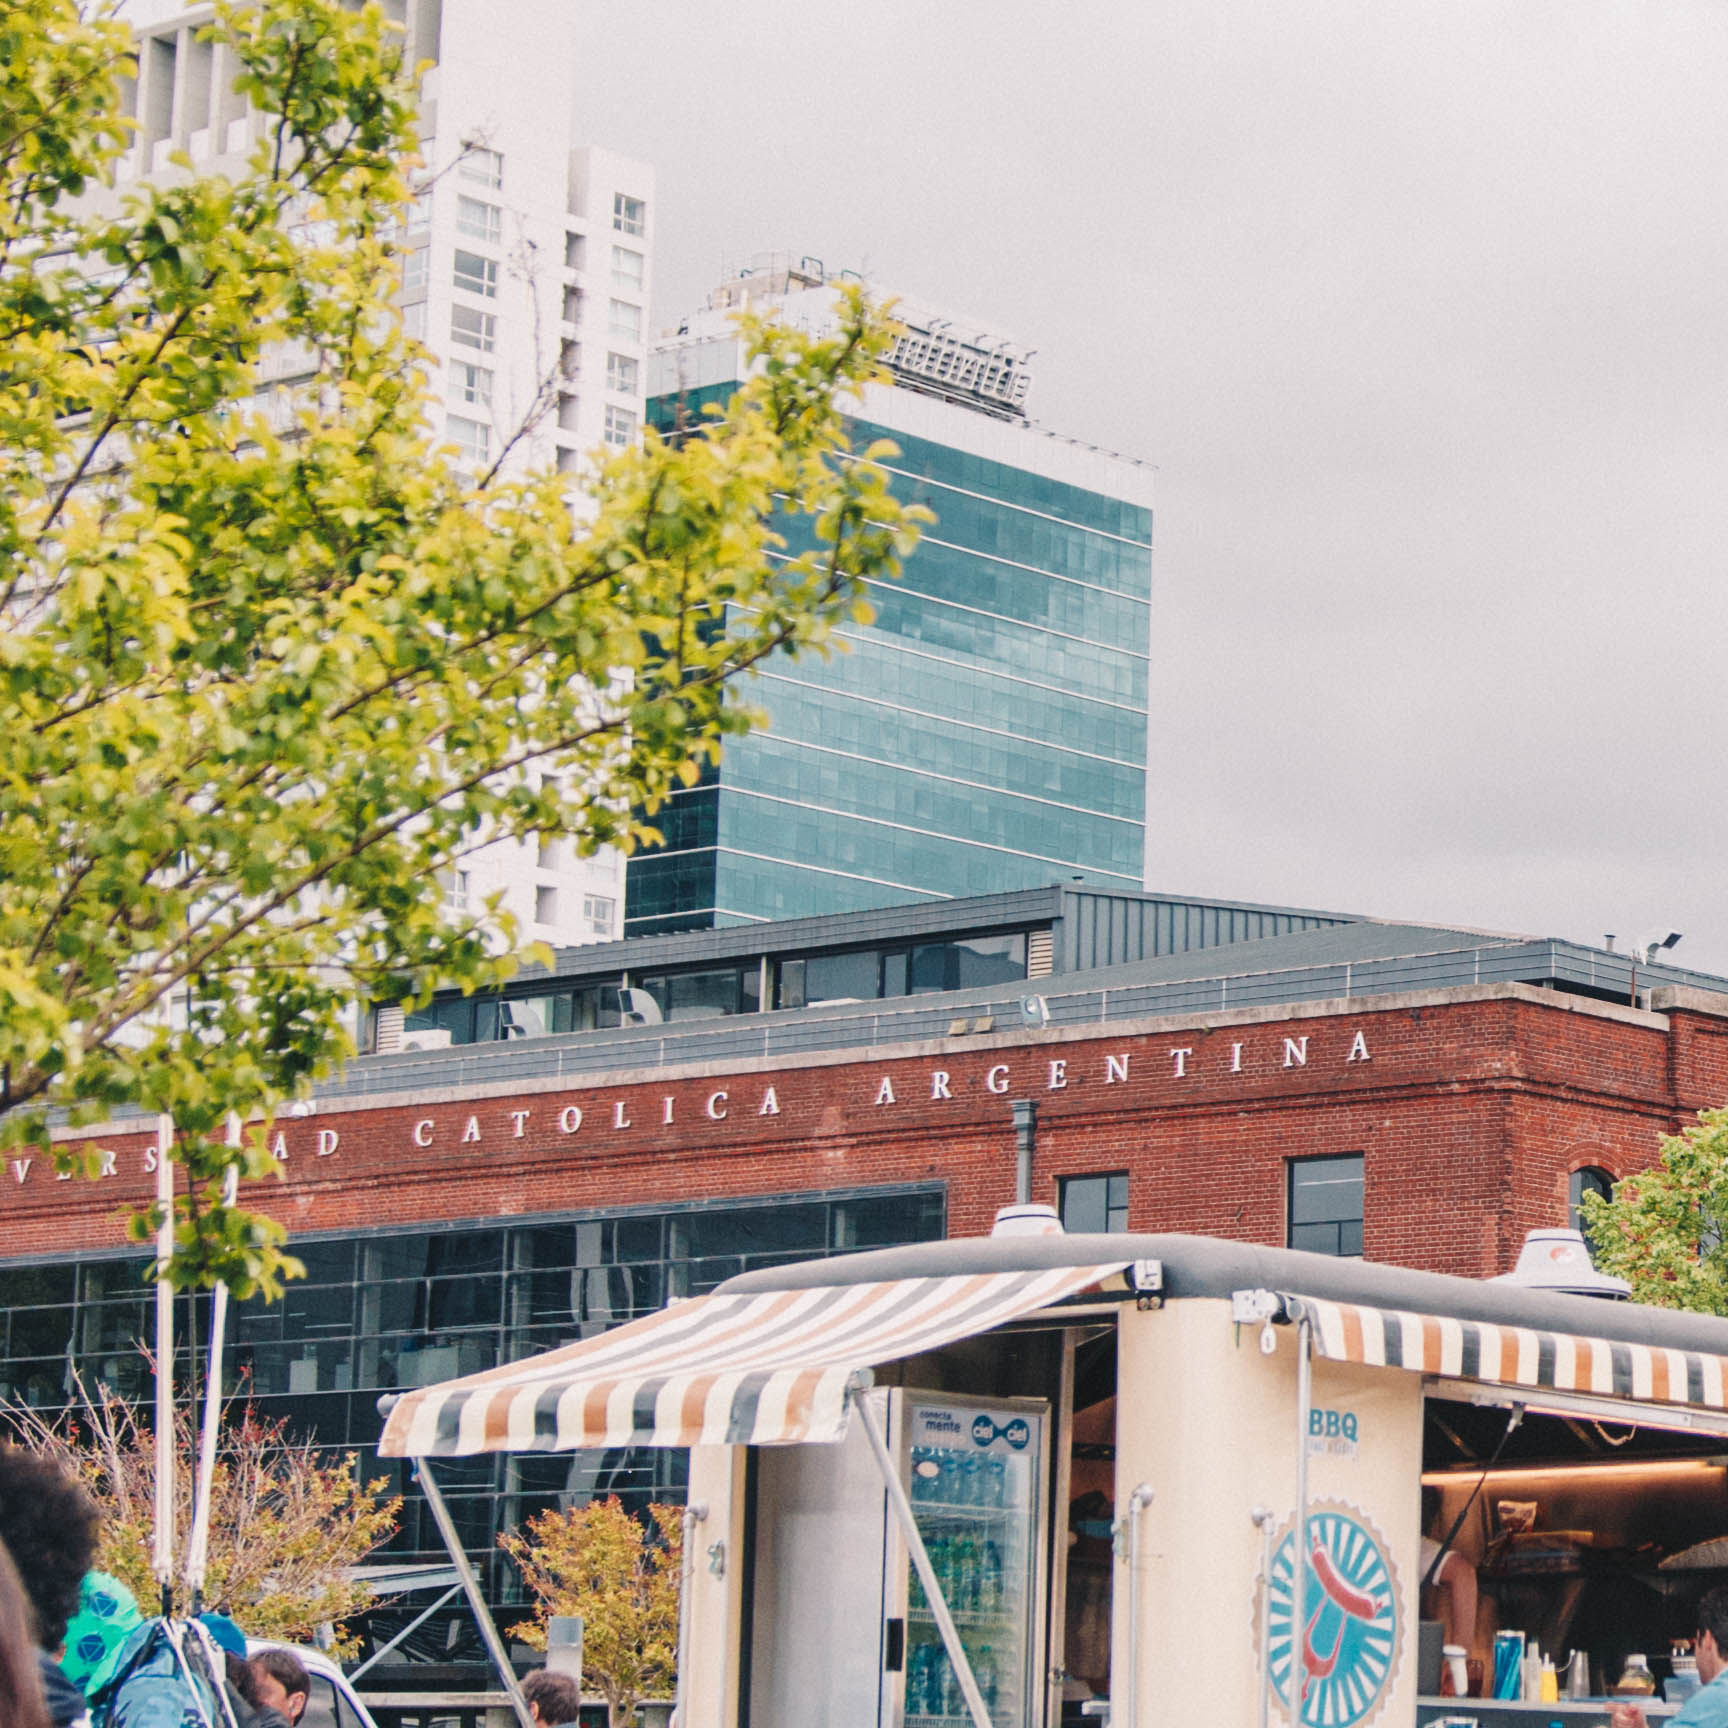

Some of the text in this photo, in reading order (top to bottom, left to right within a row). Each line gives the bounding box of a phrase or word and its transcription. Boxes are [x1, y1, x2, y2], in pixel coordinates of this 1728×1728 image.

[13, 1029, 1372, 1185] VRSAD CATOLICA ARGENTINA
[925, 1419, 961, 1434] mente
[1308, 1408, 1358, 1443] BBQ
